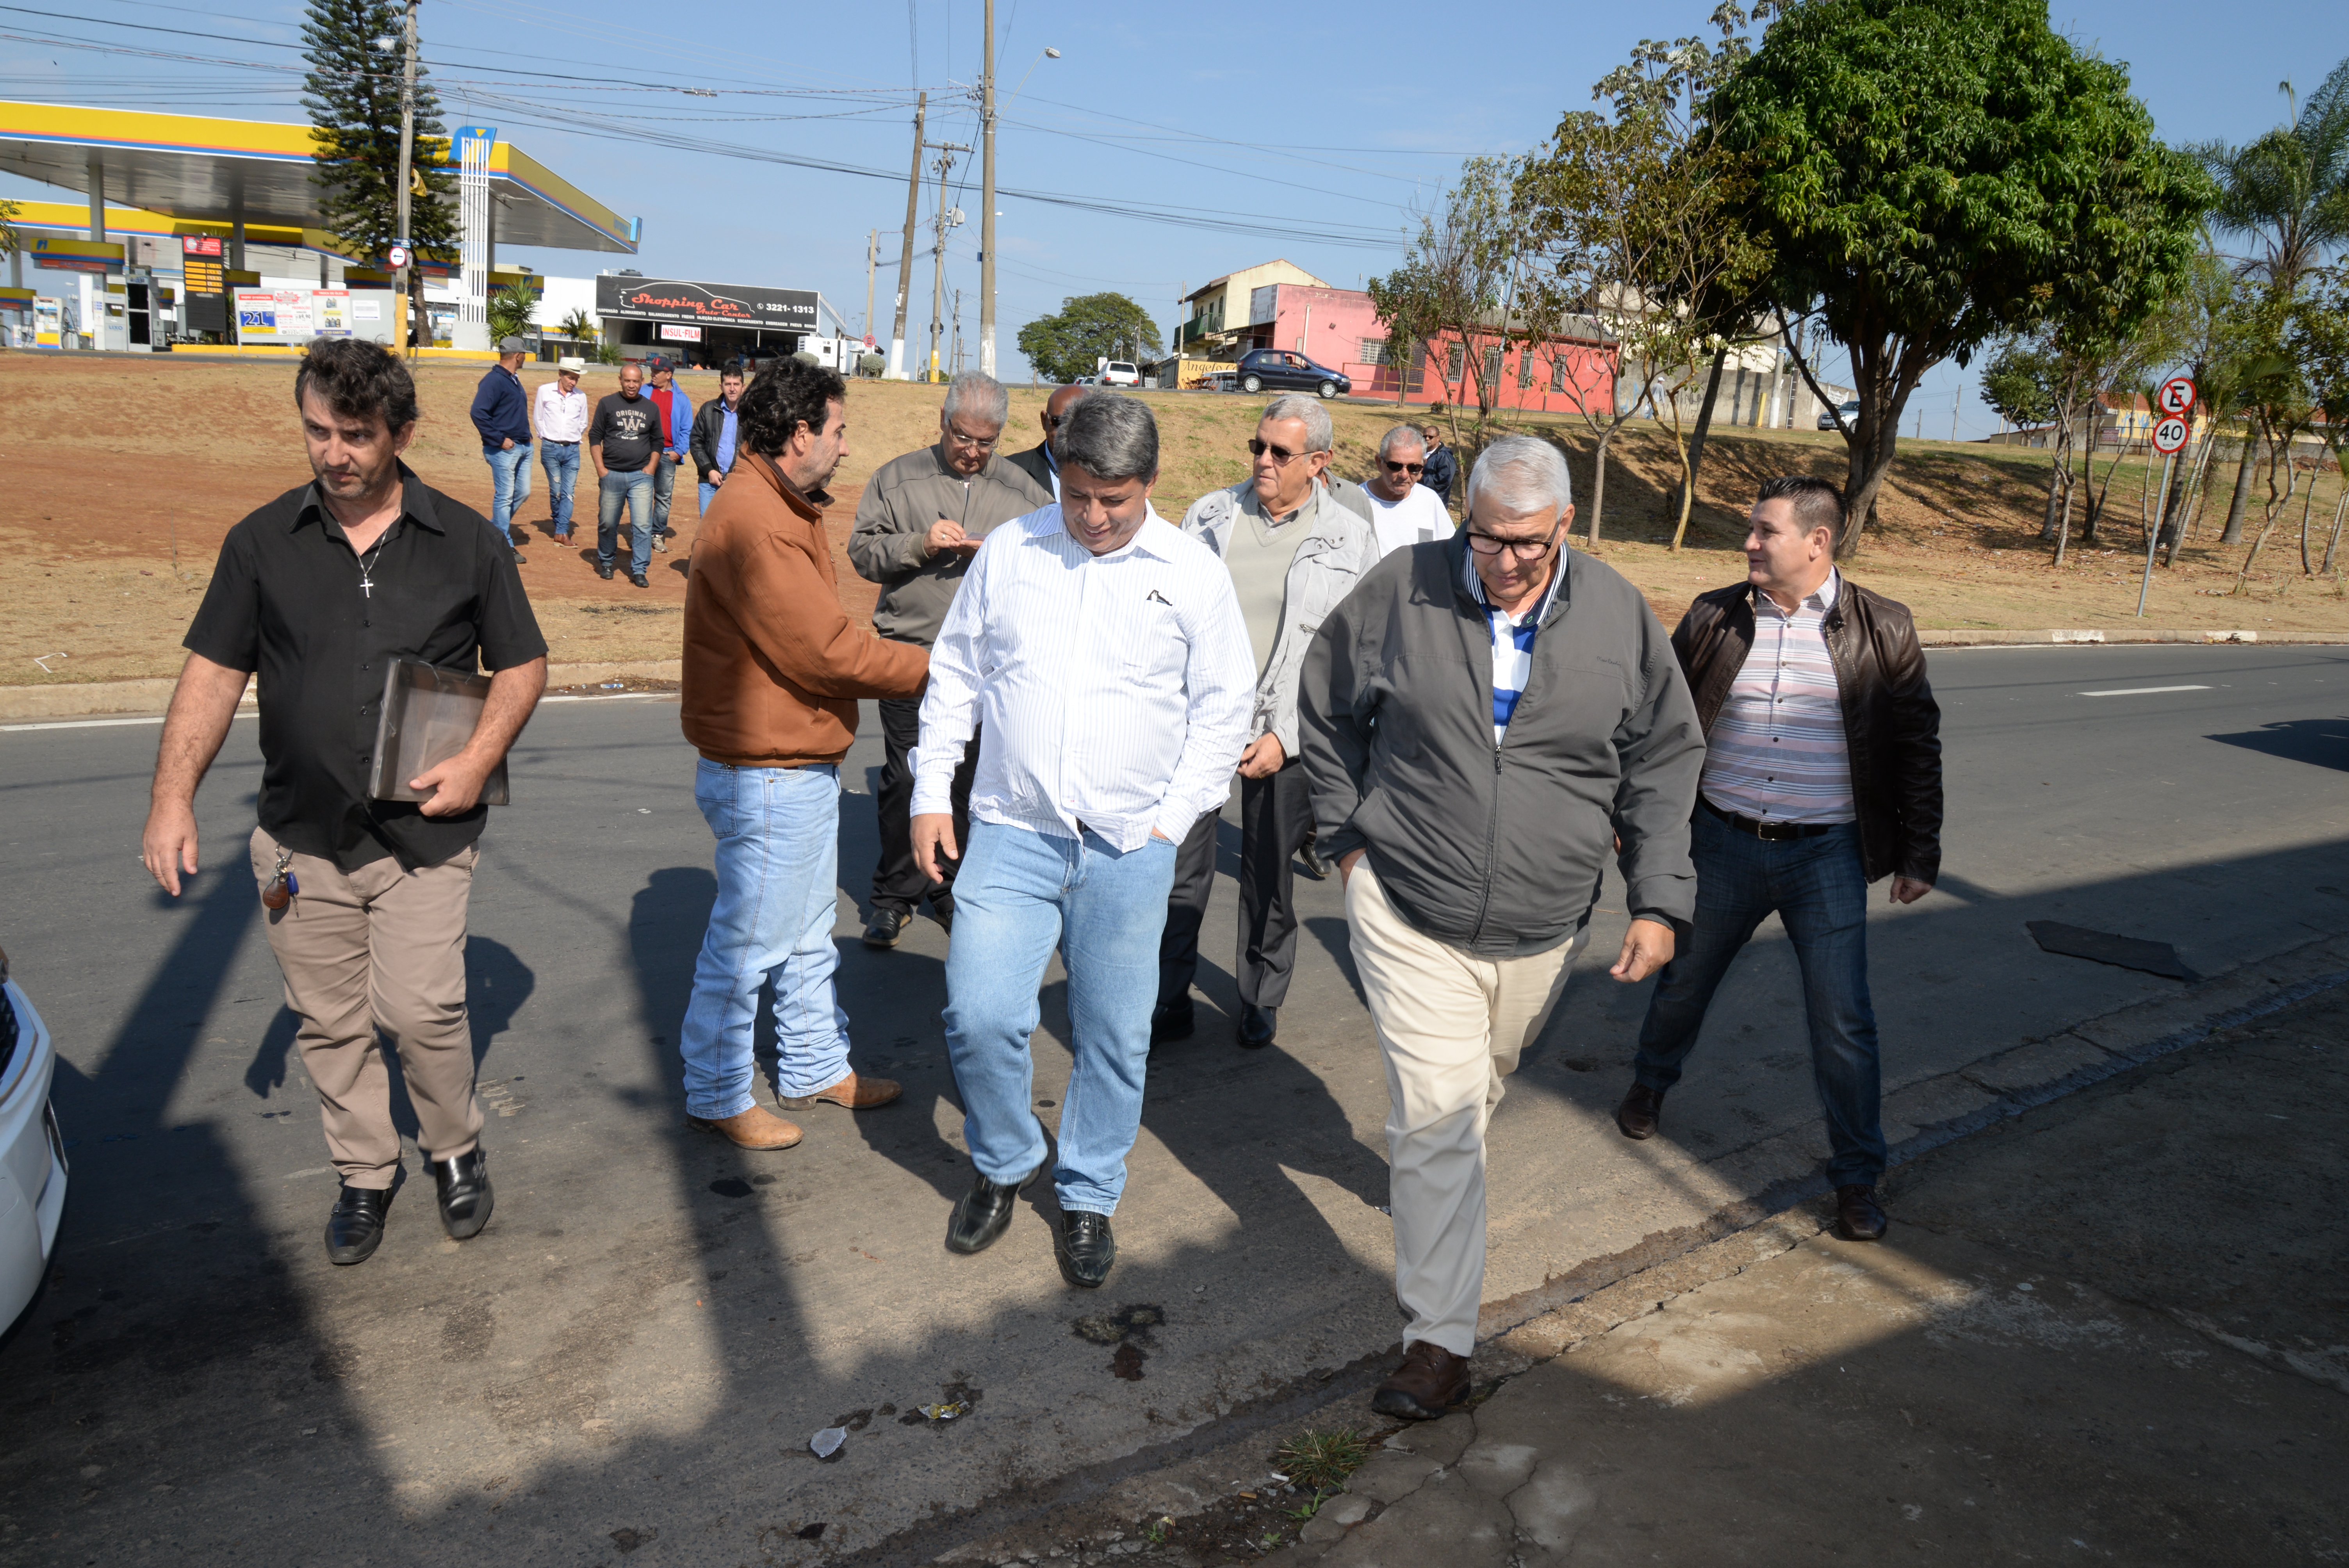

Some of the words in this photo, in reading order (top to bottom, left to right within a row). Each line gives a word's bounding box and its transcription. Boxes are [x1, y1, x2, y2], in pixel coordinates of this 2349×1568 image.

[631, 293, 705, 310] Shopping
[711, 299, 738, 310] Car
[793, 305, 814, 314] 1313
[663, 328, 700, 339] INSUL-FILM
[2169, 386, 2185, 407] E
[616, 410, 646, 420] ORIGINAL
[622, 417, 642, 431] W
[2159, 425, 2182, 441] 40
